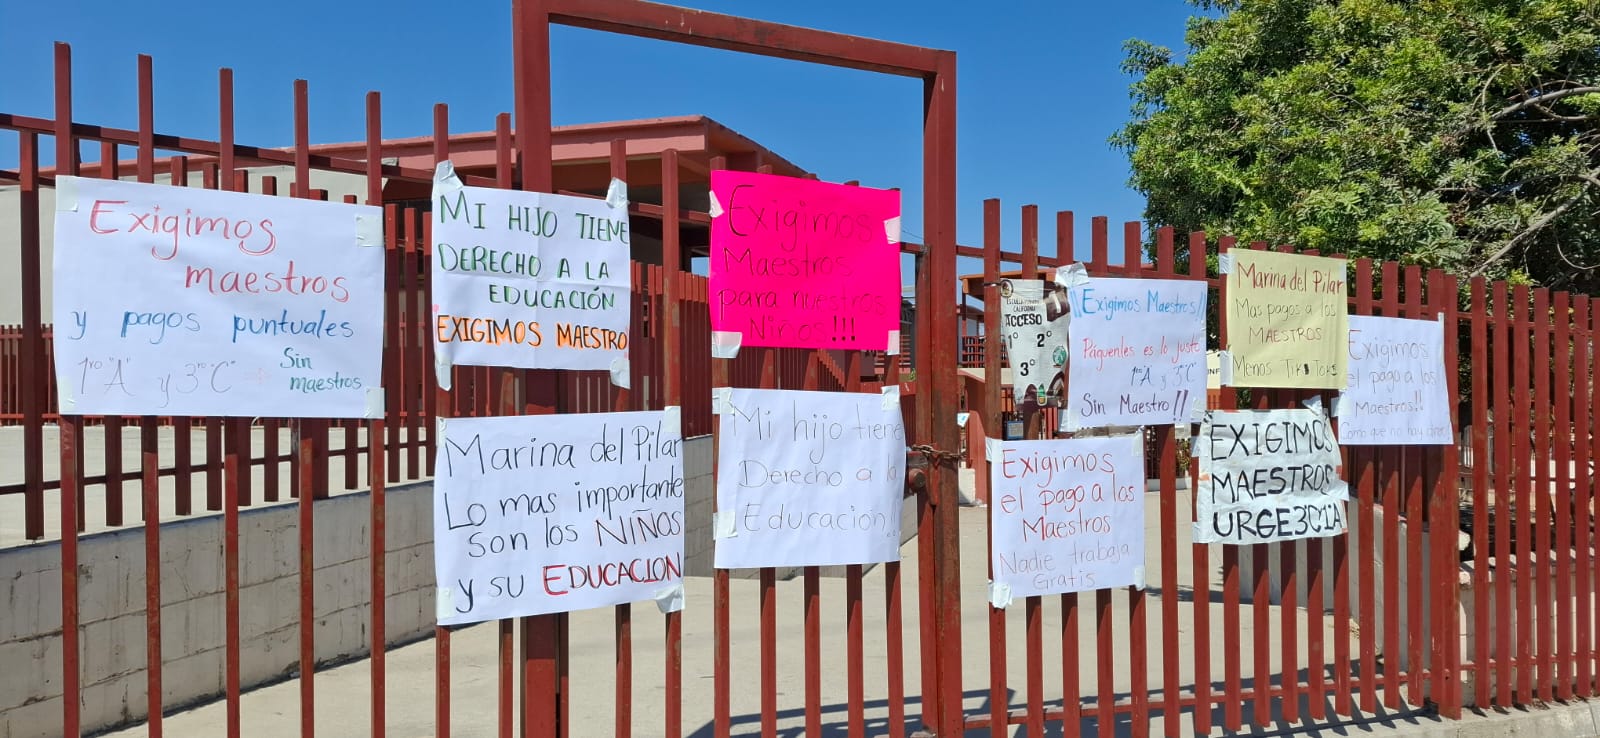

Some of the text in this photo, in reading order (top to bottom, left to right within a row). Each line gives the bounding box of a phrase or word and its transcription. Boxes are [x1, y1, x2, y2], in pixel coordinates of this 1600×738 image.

[89, 200, 277, 261] Exigimos
[440, 191, 629, 244] MI HIJO TIENE
[729, 185, 873, 252] Exigimos
[439, 243, 609, 280] DERECHO A LA
[724, 244, 853, 278] Maestros
[185, 261, 350, 302] maestros
[1238, 263, 1344, 295] Marina del Pilar
[490, 285, 615, 310] EDUCACIÓN
[719, 285, 887, 321] para nuestros
[1014, 305, 1036, 313] CALIFORNIA
[1236, 297, 1336, 324] Mas pagos a los
[68, 310, 353, 345] y pagos puntuales
[438, 315, 627, 350] EXIGIMOS MAESTRO
[1004, 314, 1042, 327] ACCESO
[1249, 327, 1322, 345] MAESTROS
[280, 348, 312, 369] Sin
[1144, 346, 1154, 356] es
[1160, 336, 1167, 355] lo
[1349, 330, 1429, 369] Exigimos
[290, 372, 362, 393] maestros
[1160, 376, 1167, 391] y
[1233, 356, 1272, 377] Menos
[1347, 368, 1437, 394] el pago a los
[158, 375, 171, 408] y
[1081, 393, 1106, 417] Sin
[445, 421, 682, 477] Marina del Pilar
[732, 400, 902, 464] Mi hijo tiene
[1210, 420, 1333, 461] EXIGIMOS
[1371, 428, 1386, 440] que
[739, 460, 843, 488] Derecho
[856, 468, 872, 481] a
[1002, 449, 1114, 488] Exigimos
[1212, 464, 1333, 504] MAESTROS
[445, 465, 683, 530] Lo mas importante
[1001, 474, 1134, 515] el pago a los
[546, 518, 578, 548] los
[596, 508, 681, 547] NIÑOS
[1023, 509, 1111, 542] Maestros
[1000, 538, 1129, 575] Nadie trabaja
[456, 579, 474, 613] y
[543, 552, 681, 595] EDUCACION
[1033, 568, 1096, 590] Gratis
